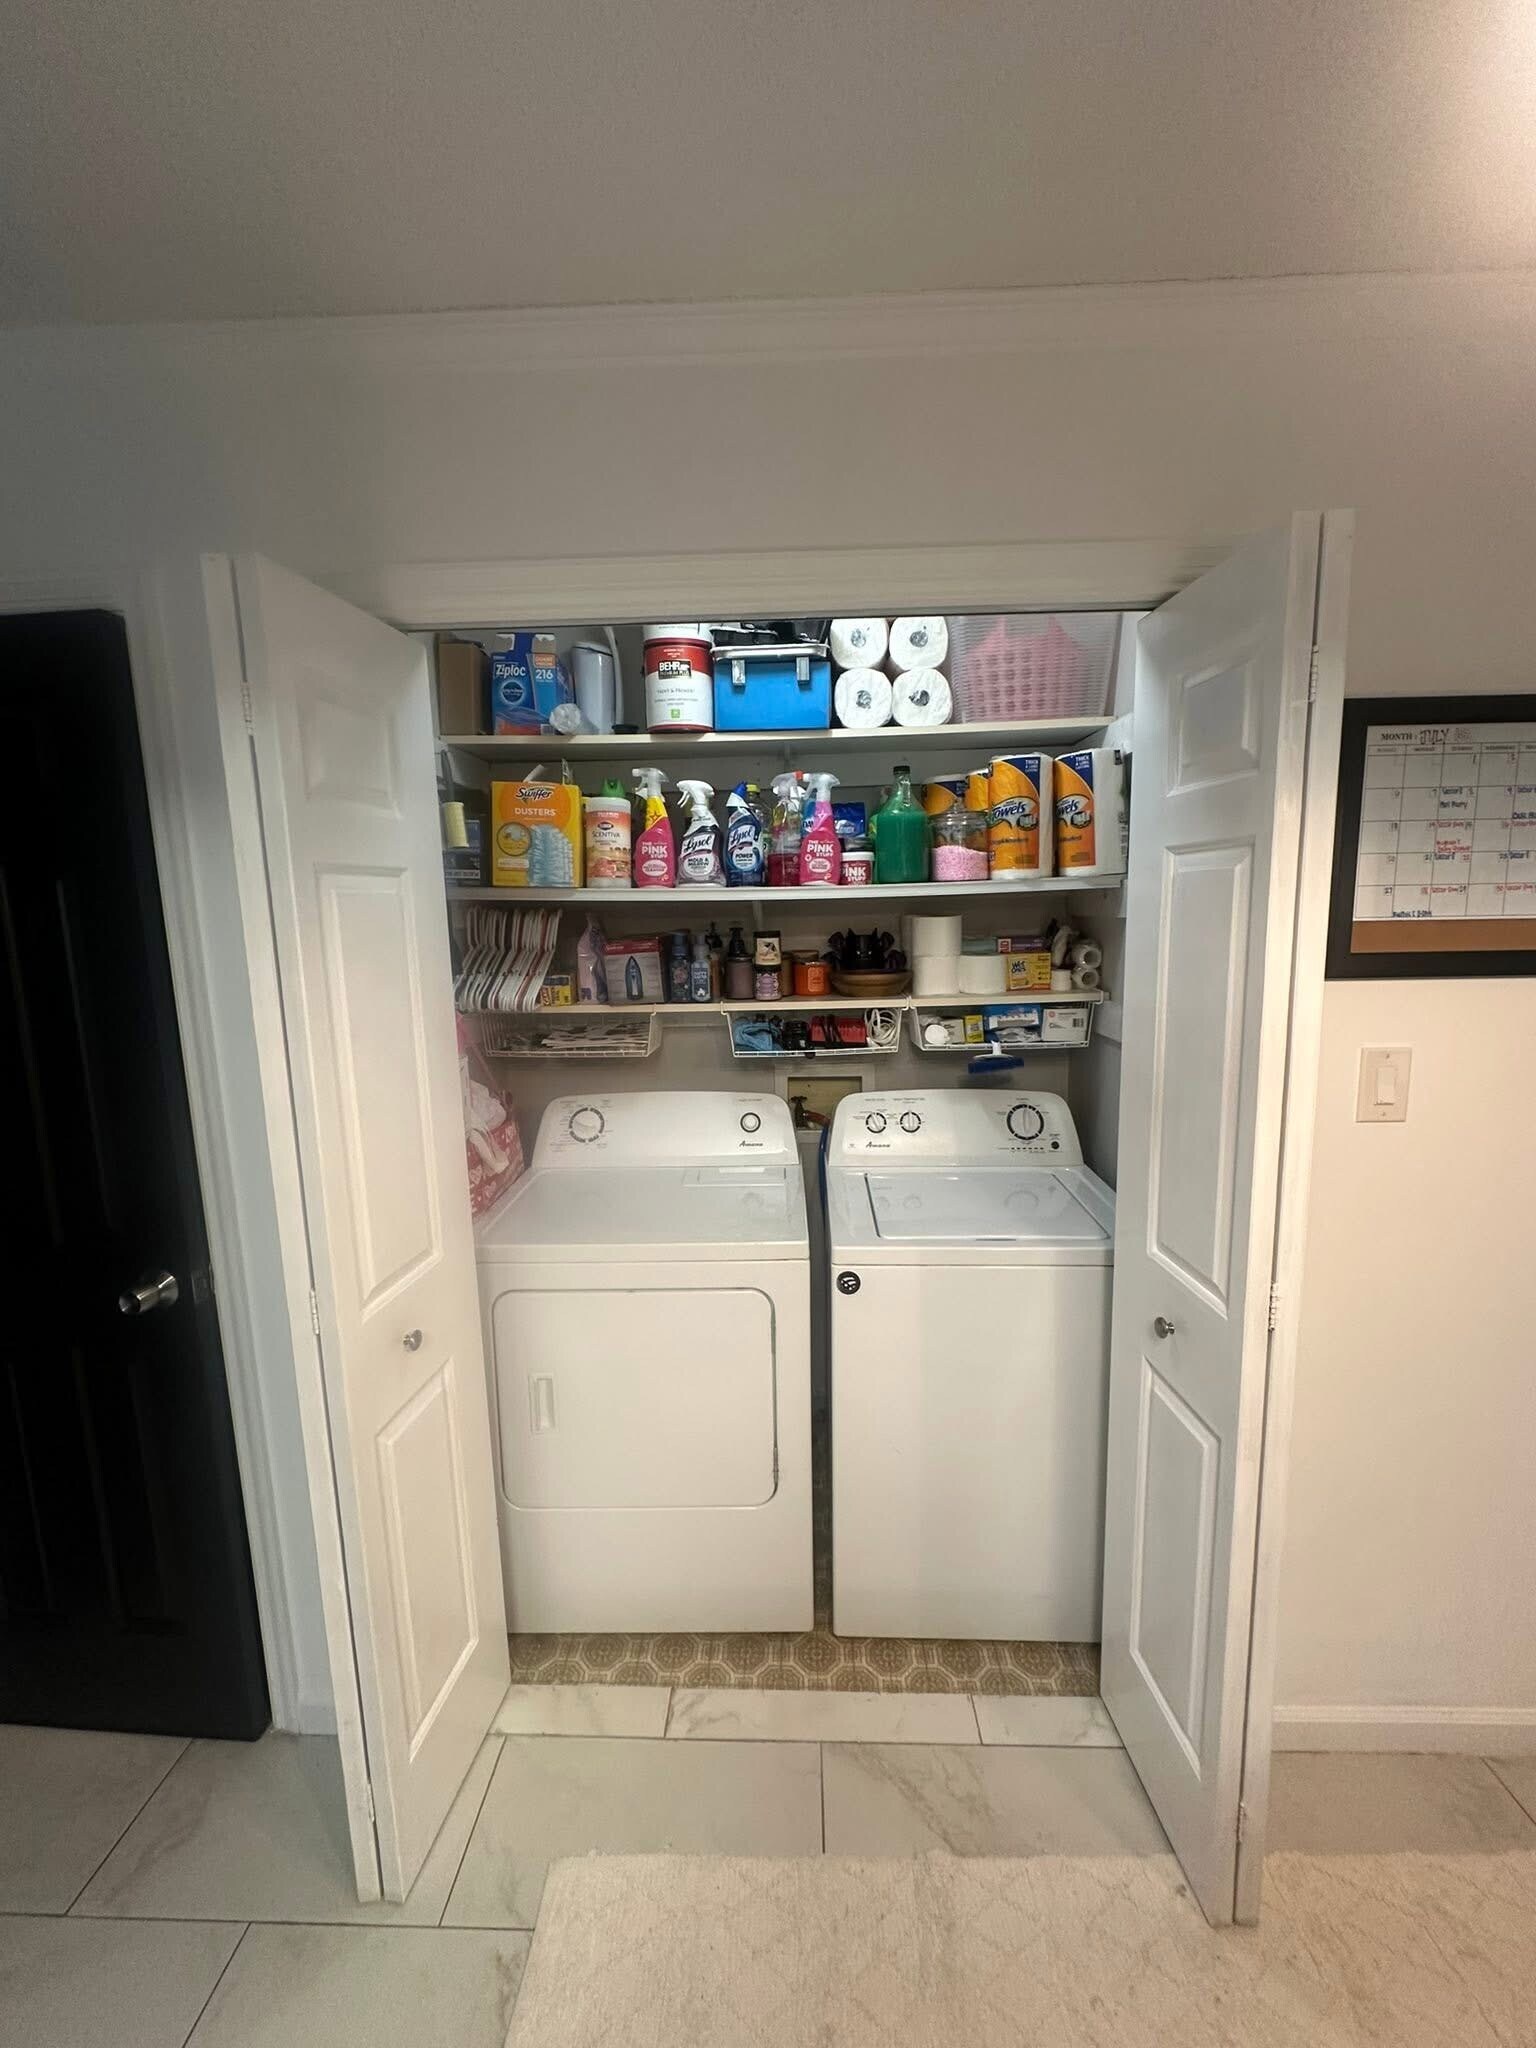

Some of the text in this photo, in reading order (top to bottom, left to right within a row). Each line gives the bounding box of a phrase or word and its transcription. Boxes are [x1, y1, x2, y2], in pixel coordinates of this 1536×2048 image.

[495, 664, 526, 679] Ziploc
[659, 661, 680, 671] BEHR
[535, 669, 554, 680] 216
[1420, 728, 1450, 745] JULY
[516, 787, 551, 801] Swiffer
[514, 807, 556, 817] DUSTERS
[731, 826, 753, 844] Lysol
[641, 845, 668, 855] PINK
[685, 836, 711, 852] Lysol
[807, 844, 833, 853] PINK
